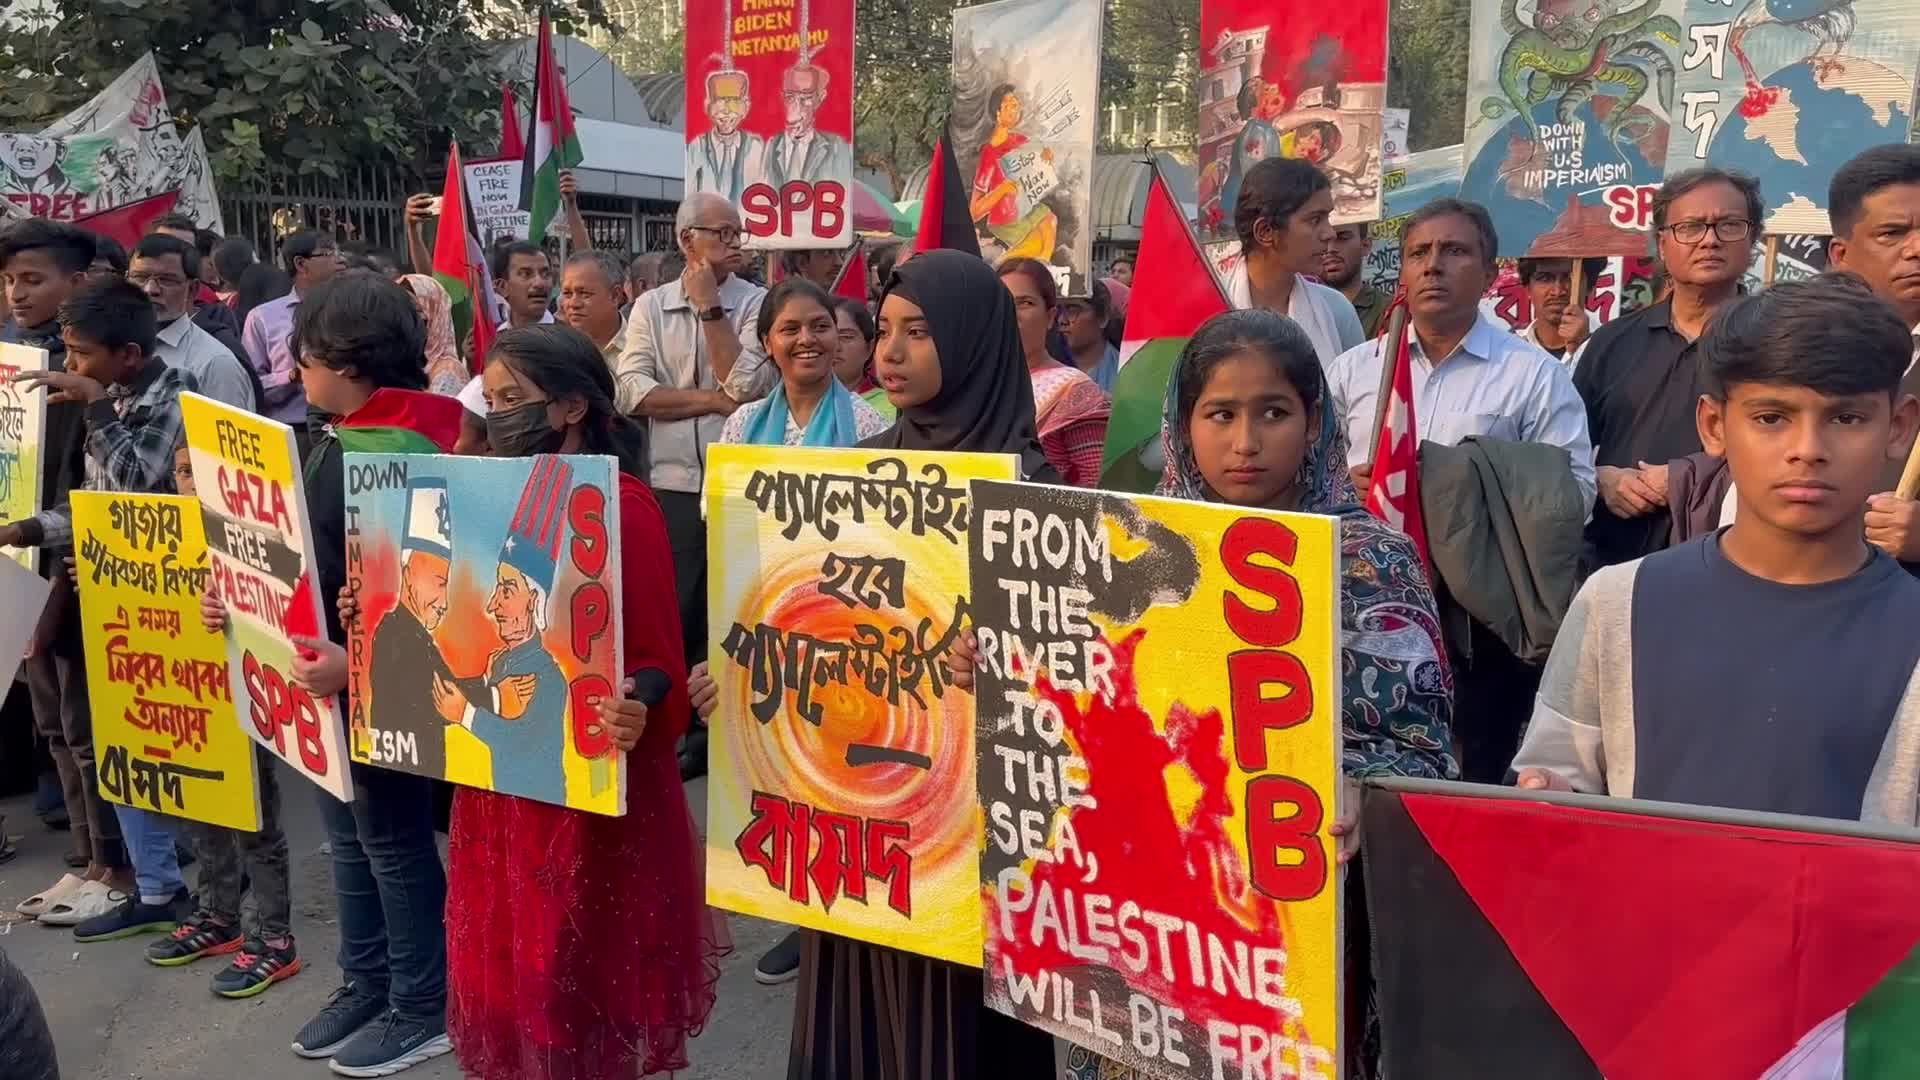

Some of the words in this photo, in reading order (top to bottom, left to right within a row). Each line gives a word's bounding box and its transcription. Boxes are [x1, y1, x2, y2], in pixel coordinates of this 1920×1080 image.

[732, 30, 829, 56] NETANYAHU
[735, 11, 792, 34] BIDEN
[1539, 121, 1585, 139] DOWN
[1543, 136, 1583, 151] WITH
[473, 164, 511, 177] CEASE
[479, 178, 509, 191] FIRE
[481, 193, 508, 203] NOW
[1523, 161, 1627, 189] IMPERIALISM
[741, 180, 846, 239] SPB
[215, 420, 265, 470] FREE
[217, 465, 292, 535] GAZA
[349, 461, 409, 496] DOWN
[108, 500, 182, 553] গাজায়
[223, 521, 272, 572] FREE
[983, 508, 1113, 583] FROM
[817, 552, 907, 609] হবে
[998, 577, 1096, 637] THE
[103, 604, 130, 632] এ
[137, 606, 181, 639] সময়
[568, 483, 615, 760] SPB
[977, 627, 1117, 709] RIVER
[243, 648, 327, 777] SPB
[1003, 689, 1065, 747] TO
[1219, 516, 1327, 902] SPB
[99, 745, 225, 811] বাসদ
[993, 744, 1098, 810] THE
[735, 789, 912, 921] বাসদ
[990, 800, 1099, 884] SEA,
[997, 866, 1303, 1019] PALESTINE
[1003, 954, 1124, 1046] WILL
[1129, 993, 1191, 1067] BE
[1207, 1019, 1335, 1080] FREE
